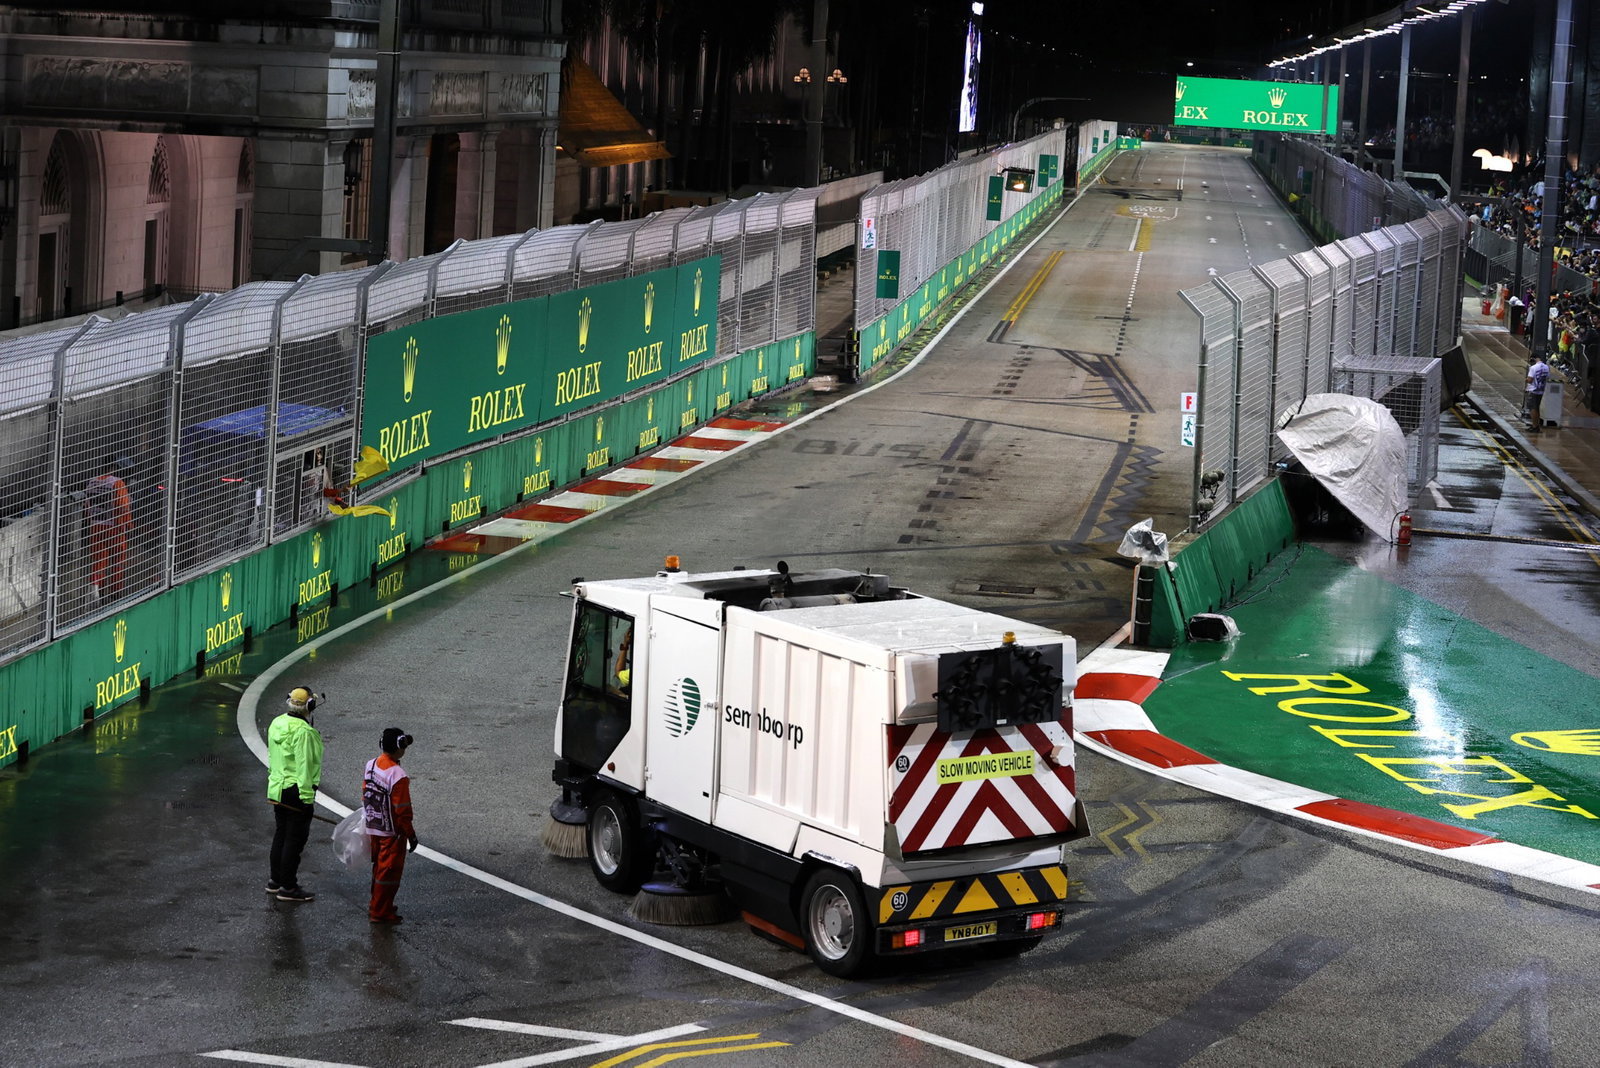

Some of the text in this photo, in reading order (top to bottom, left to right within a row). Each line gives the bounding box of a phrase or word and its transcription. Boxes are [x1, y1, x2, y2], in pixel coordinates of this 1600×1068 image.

[1242, 110, 1308, 127] ROLEX
[866, 219, 871, 228] F
[680, 324, 708, 363] ROLEX
[626, 342, 663, 382] ROLEX
[789, 363, 804, 380] ROLEX
[555, 361, 601, 406] ROLEX
[752, 376, 768, 393] ROLEX
[468, 384, 526, 433] ROLEX
[717, 391, 730, 410] ROLEX
[1186, 396, 1192, 409] F
[682, 407, 697, 427] ROLEX
[379, 410, 432, 465] ROLEX
[639, 426, 658, 448] ROLEX
[587, 447, 609, 469] ROLEX
[523, 470, 550, 496] ROLEX
[450, 496, 481, 522] ROLEX
[378, 532, 406, 564] ROLEX
[298, 570, 331, 605] ROLEX
[205, 612, 245, 653] ROLEX
[96, 662, 141, 709] ROLEX
[1221, 670, 1600, 820] ROLEX
[898, 757, 908, 767] 60
[940, 755, 1031, 778] SLOW MOVING VEHICLE
[893, 894, 905, 905] 60
